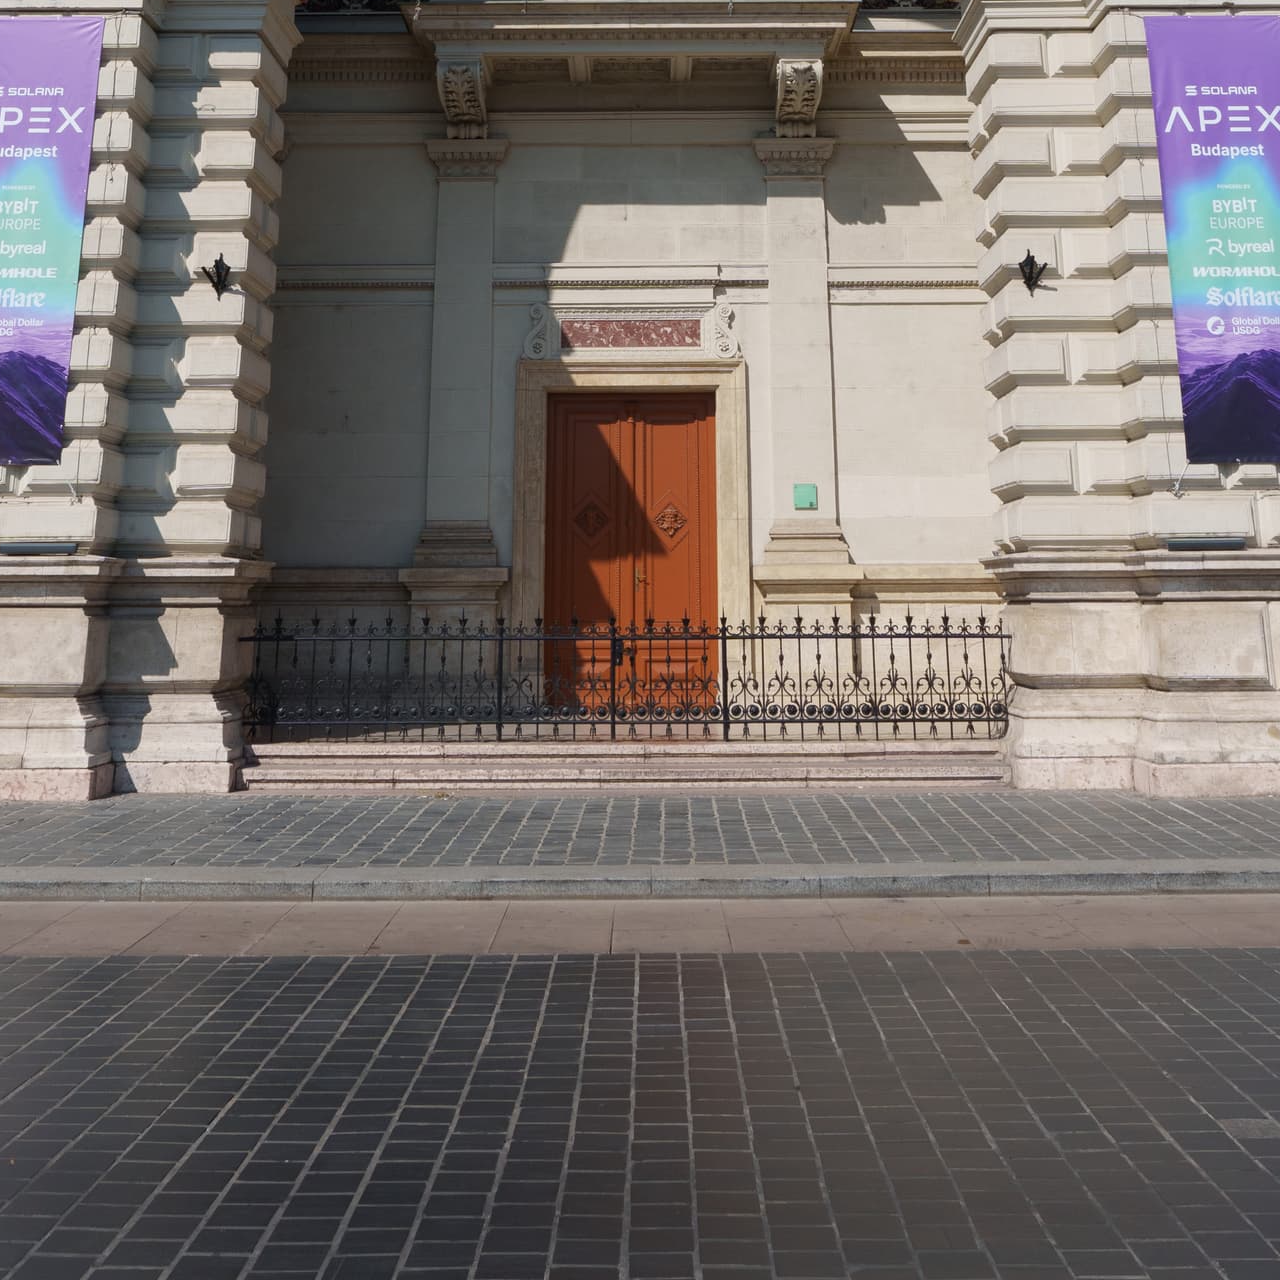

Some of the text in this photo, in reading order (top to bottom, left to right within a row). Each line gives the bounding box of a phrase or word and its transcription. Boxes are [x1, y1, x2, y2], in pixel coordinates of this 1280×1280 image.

[8, 88, 64, 96] SOLANA
[1200, 86, 1258, 95] SOLANA
[1190, 143, 1264, 159] Budapest
[1212, 197, 1256, 213] BYBIT
[1210, 216, 1264, 229] EUROPE
[0, 240, 46, 258] byreal
[1228, 238, 1274, 257] byreal
[18, 318, 44, 327] Dollar
[1232, 316, 1262, 326] Global
[1232, 326, 1260, 335] USDG
